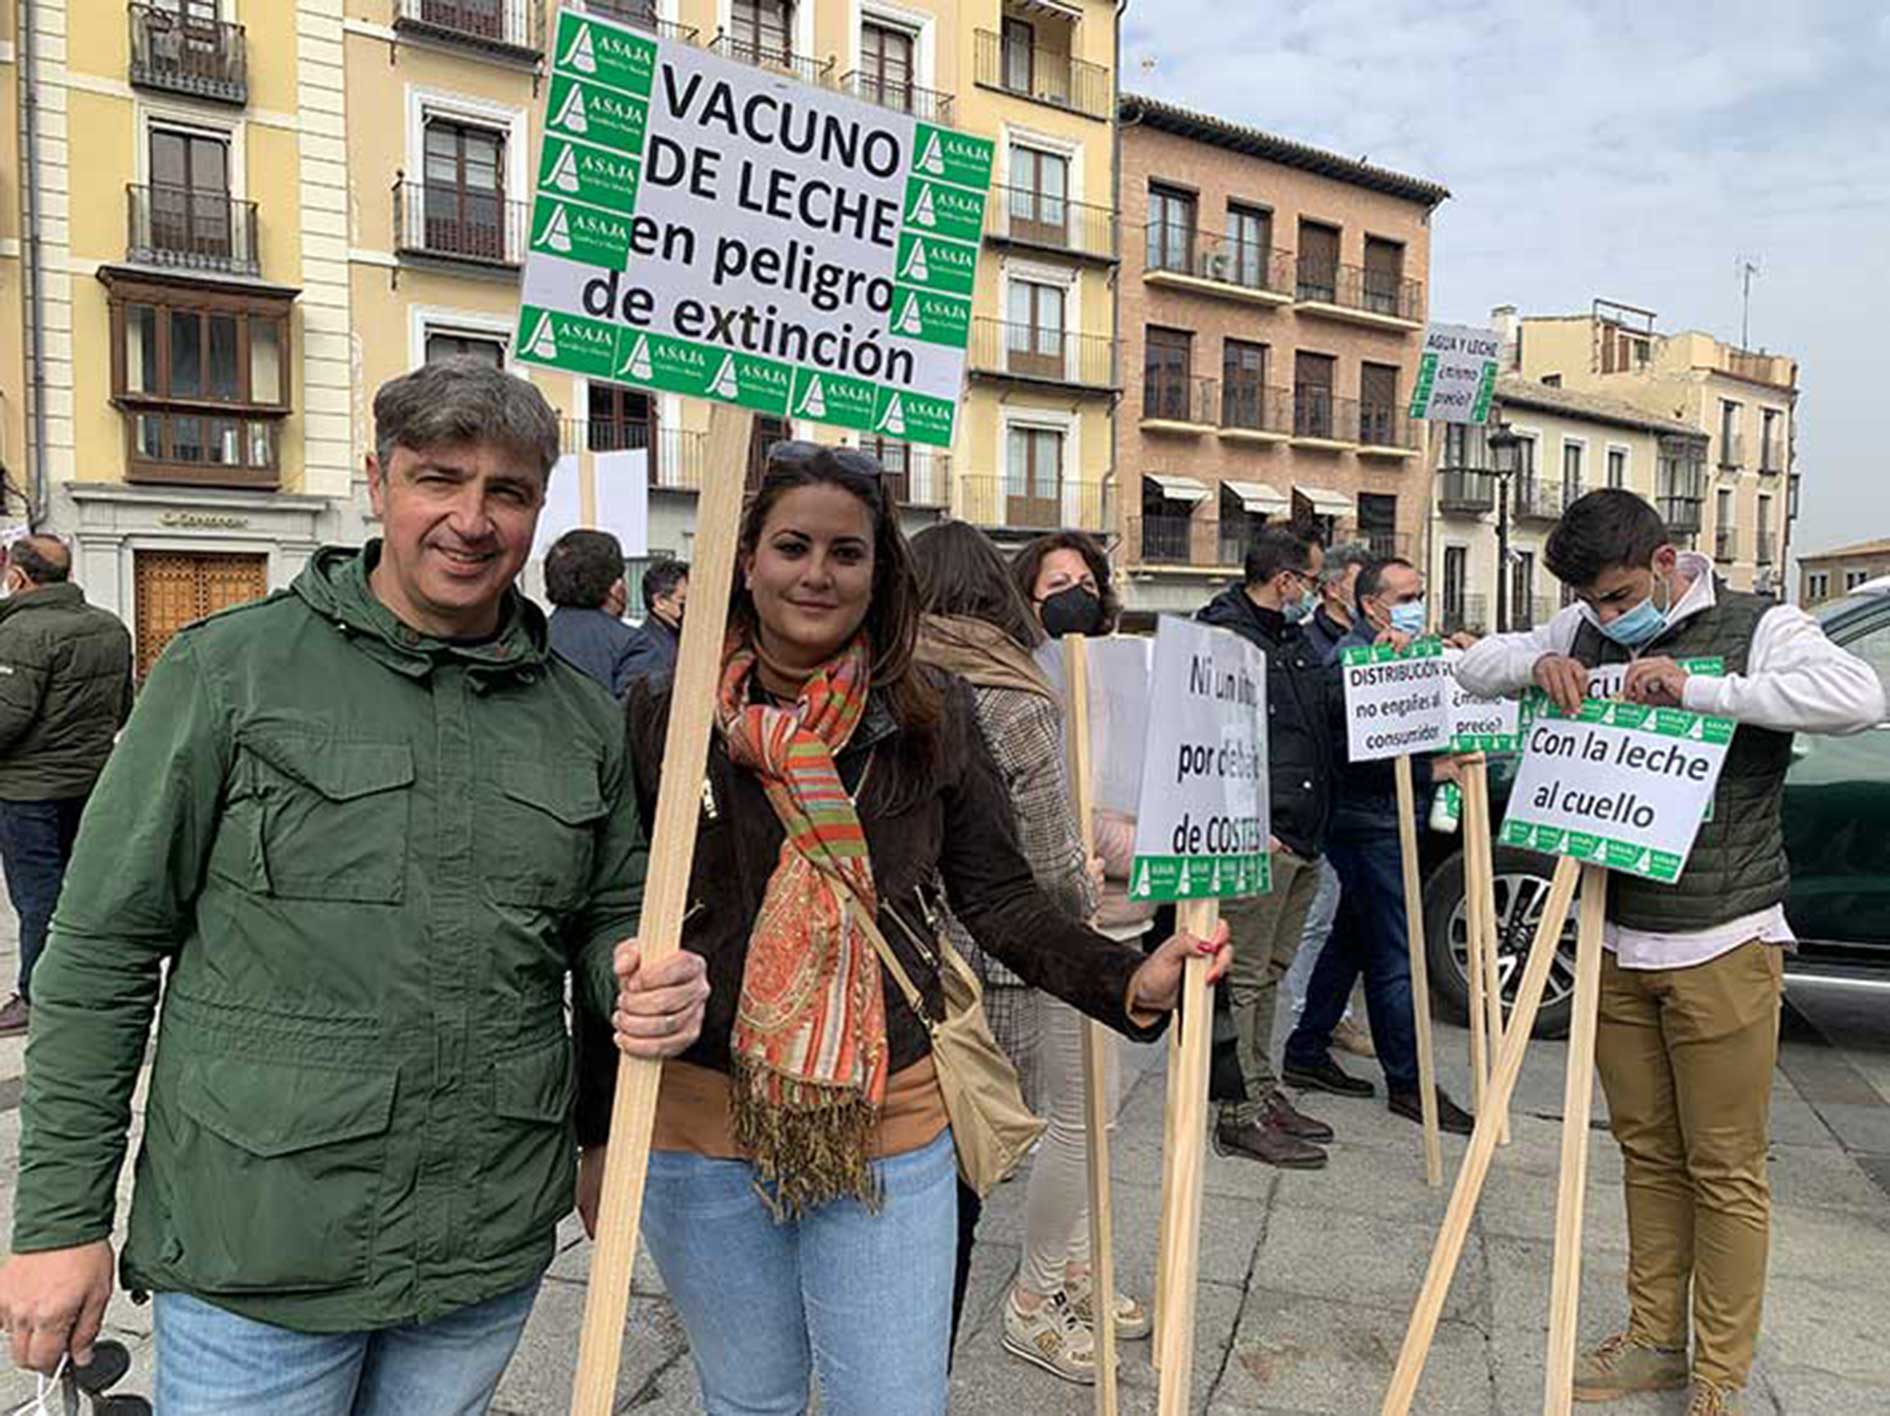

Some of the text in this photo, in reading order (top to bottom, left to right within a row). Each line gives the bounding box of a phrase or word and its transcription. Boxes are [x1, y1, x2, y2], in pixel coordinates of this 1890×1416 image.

[597, 37, 652, 66] ASAJA
[589, 96, 644, 124] ASAJA
[661, 63, 901, 179] VACUNO
[580, 155, 636, 182] ASAJA
[645, 133, 899, 248] DE LECHE
[630, 214, 896, 312] en peligro
[558, 322, 614, 346] ASAJA
[582, 269, 915, 385] de extinción
[654, 344, 706, 367] ASAJA
[739, 362, 788, 386] ASAJA
[826, 382, 873, 405] ASAJA
[905, 399, 951, 421] ASAJA
[1189, 655, 1213, 695] Ni
[1356, 703, 1378, 718] no
[1177, 743, 1215, 784] por
[1531, 727, 1710, 781] Con la leche
[1534, 780, 1656, 828] al cuello
[1173, 812, 1202, 855] de
